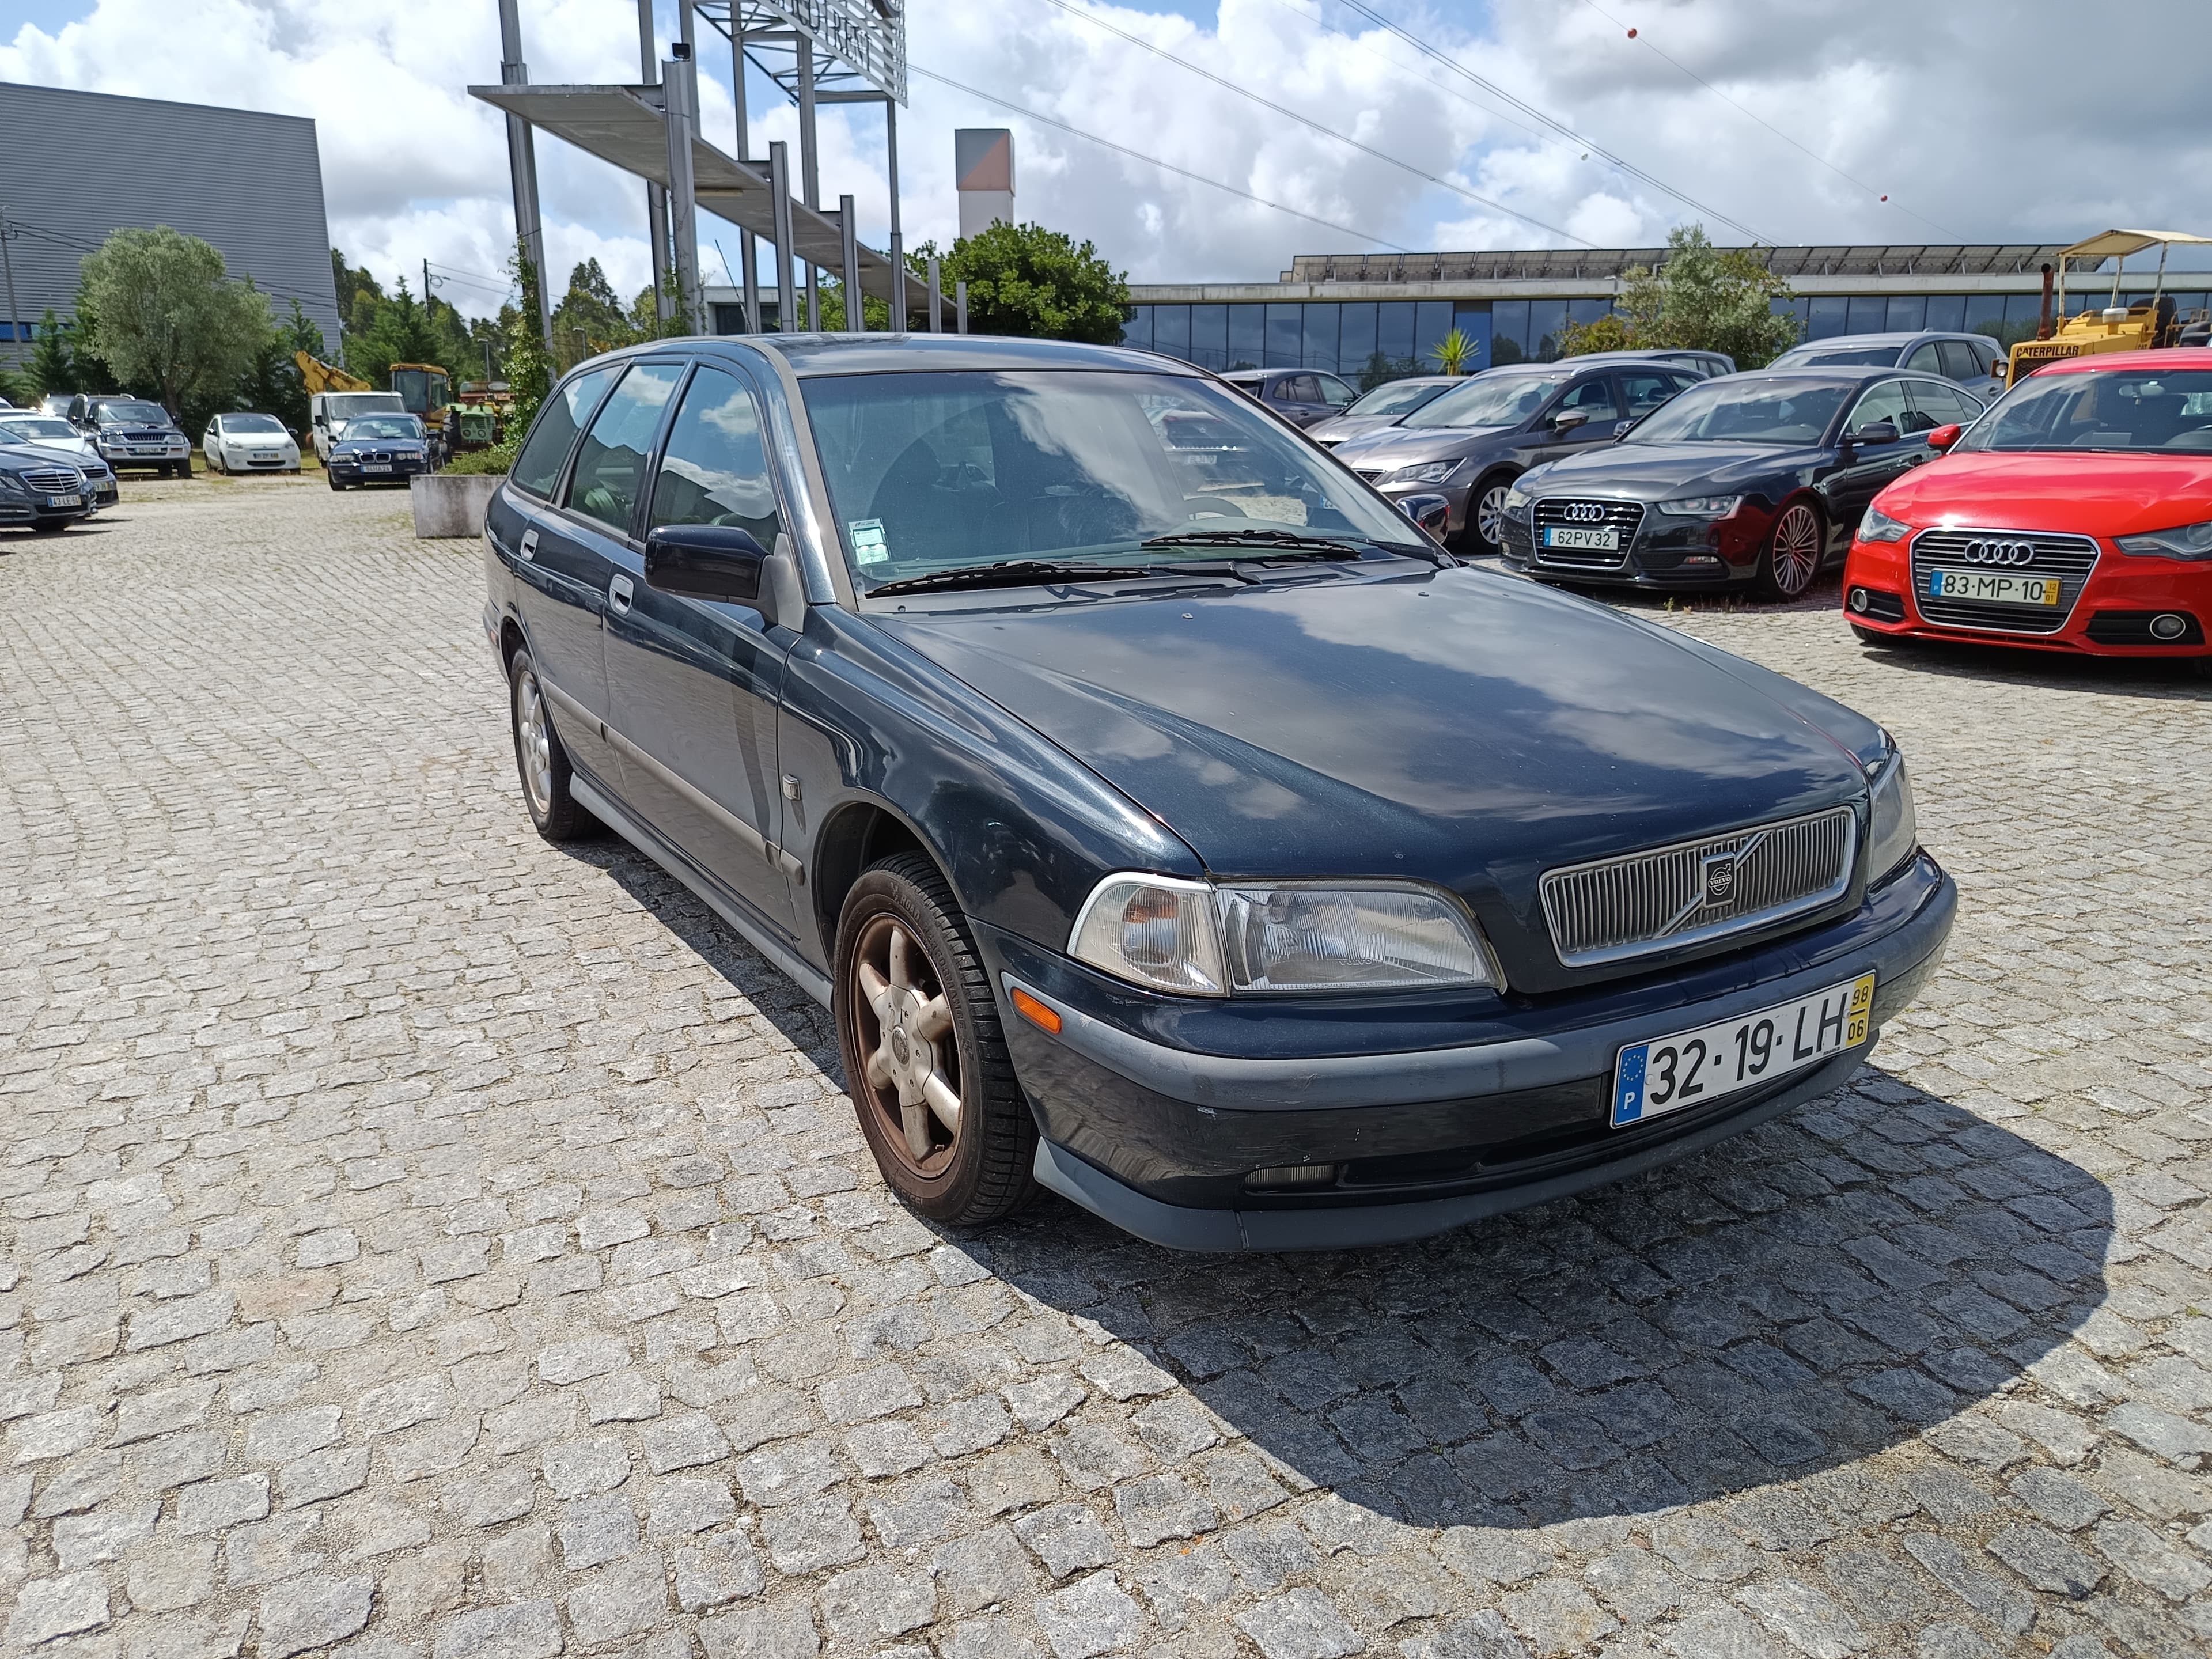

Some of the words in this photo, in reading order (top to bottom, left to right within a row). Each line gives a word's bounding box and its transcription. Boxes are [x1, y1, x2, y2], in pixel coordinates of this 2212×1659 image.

[2016, 346, 2079, 357] CATERPILLAR
[1710, 877, 1730, 885] VOLVO
[900, 895, 921, 920] ROAD
[1338, 958, 1372, 966] VOLVO
[1852, 986, 1869, 1006] 98
[1848, 1019, 1865, 1040] 06
[1623, 1092, 1635, 1110] P
